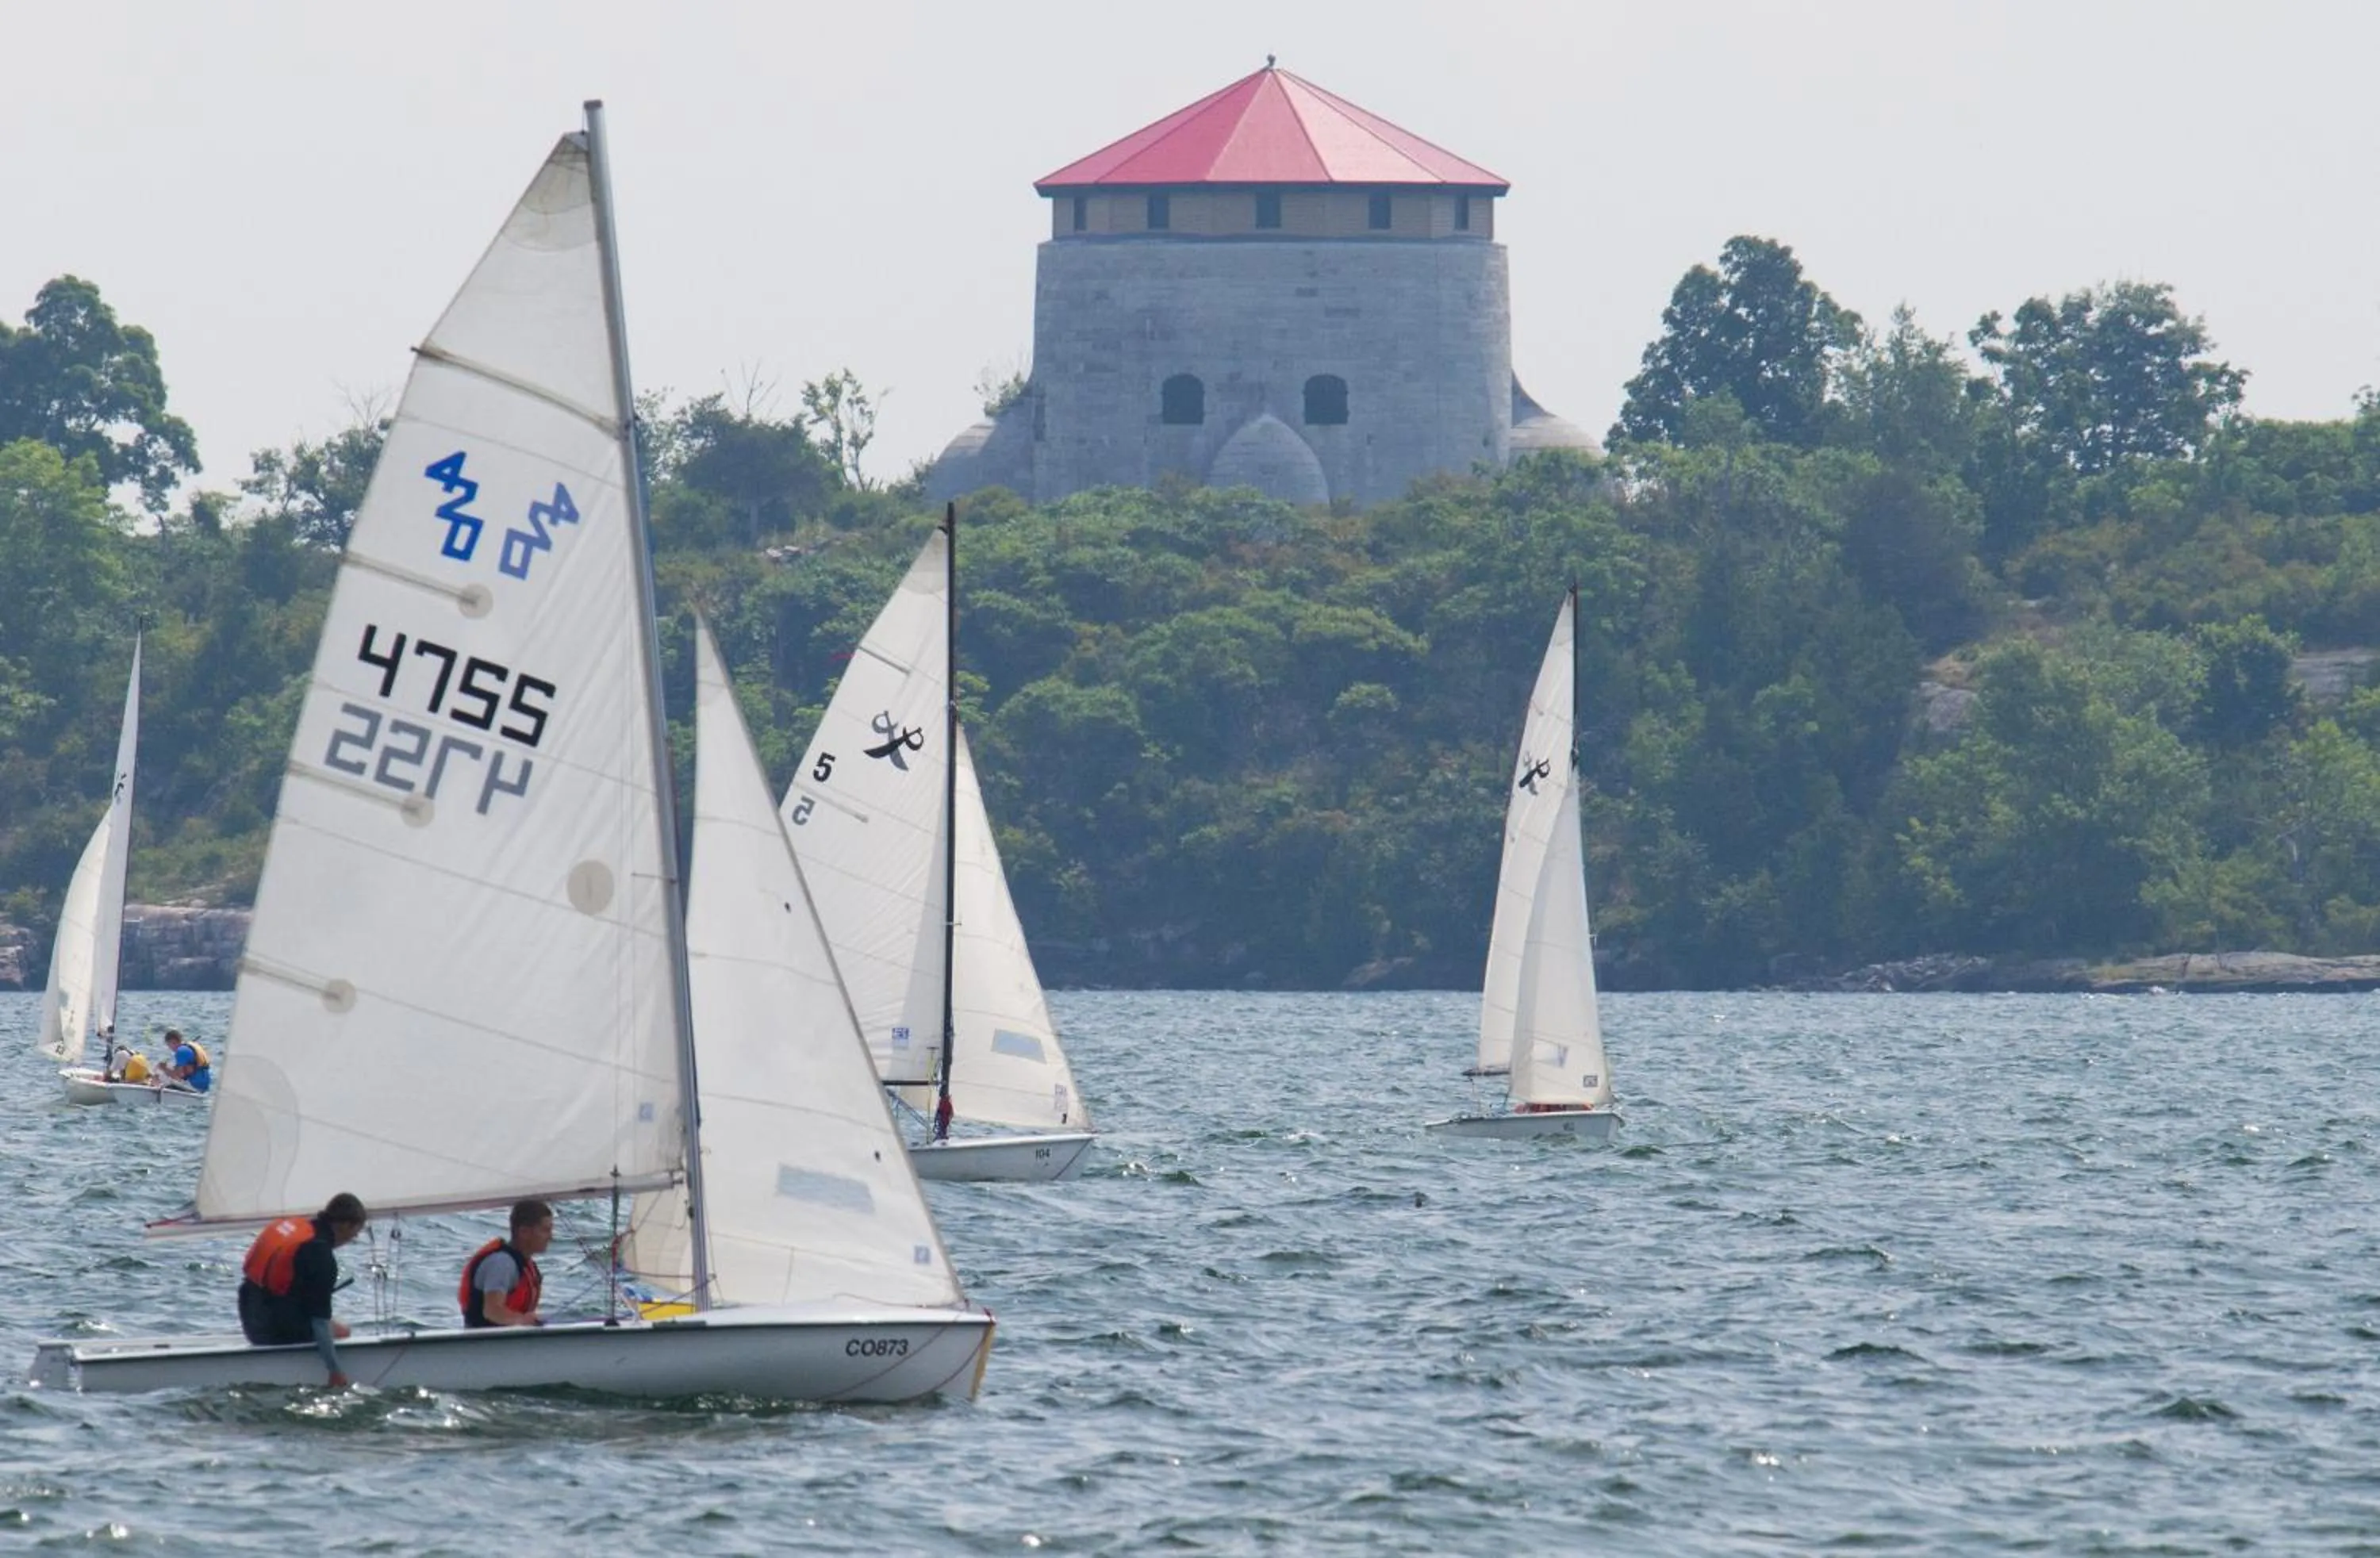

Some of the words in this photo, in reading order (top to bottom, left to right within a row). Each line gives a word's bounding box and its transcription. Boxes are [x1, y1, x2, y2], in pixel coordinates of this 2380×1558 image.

[424, 451, 484, 562] 420
[357, 623, 557, 748] 4755
[812, 751, 836, 782] 5
[846, 1338, 909, 1357] CO873
